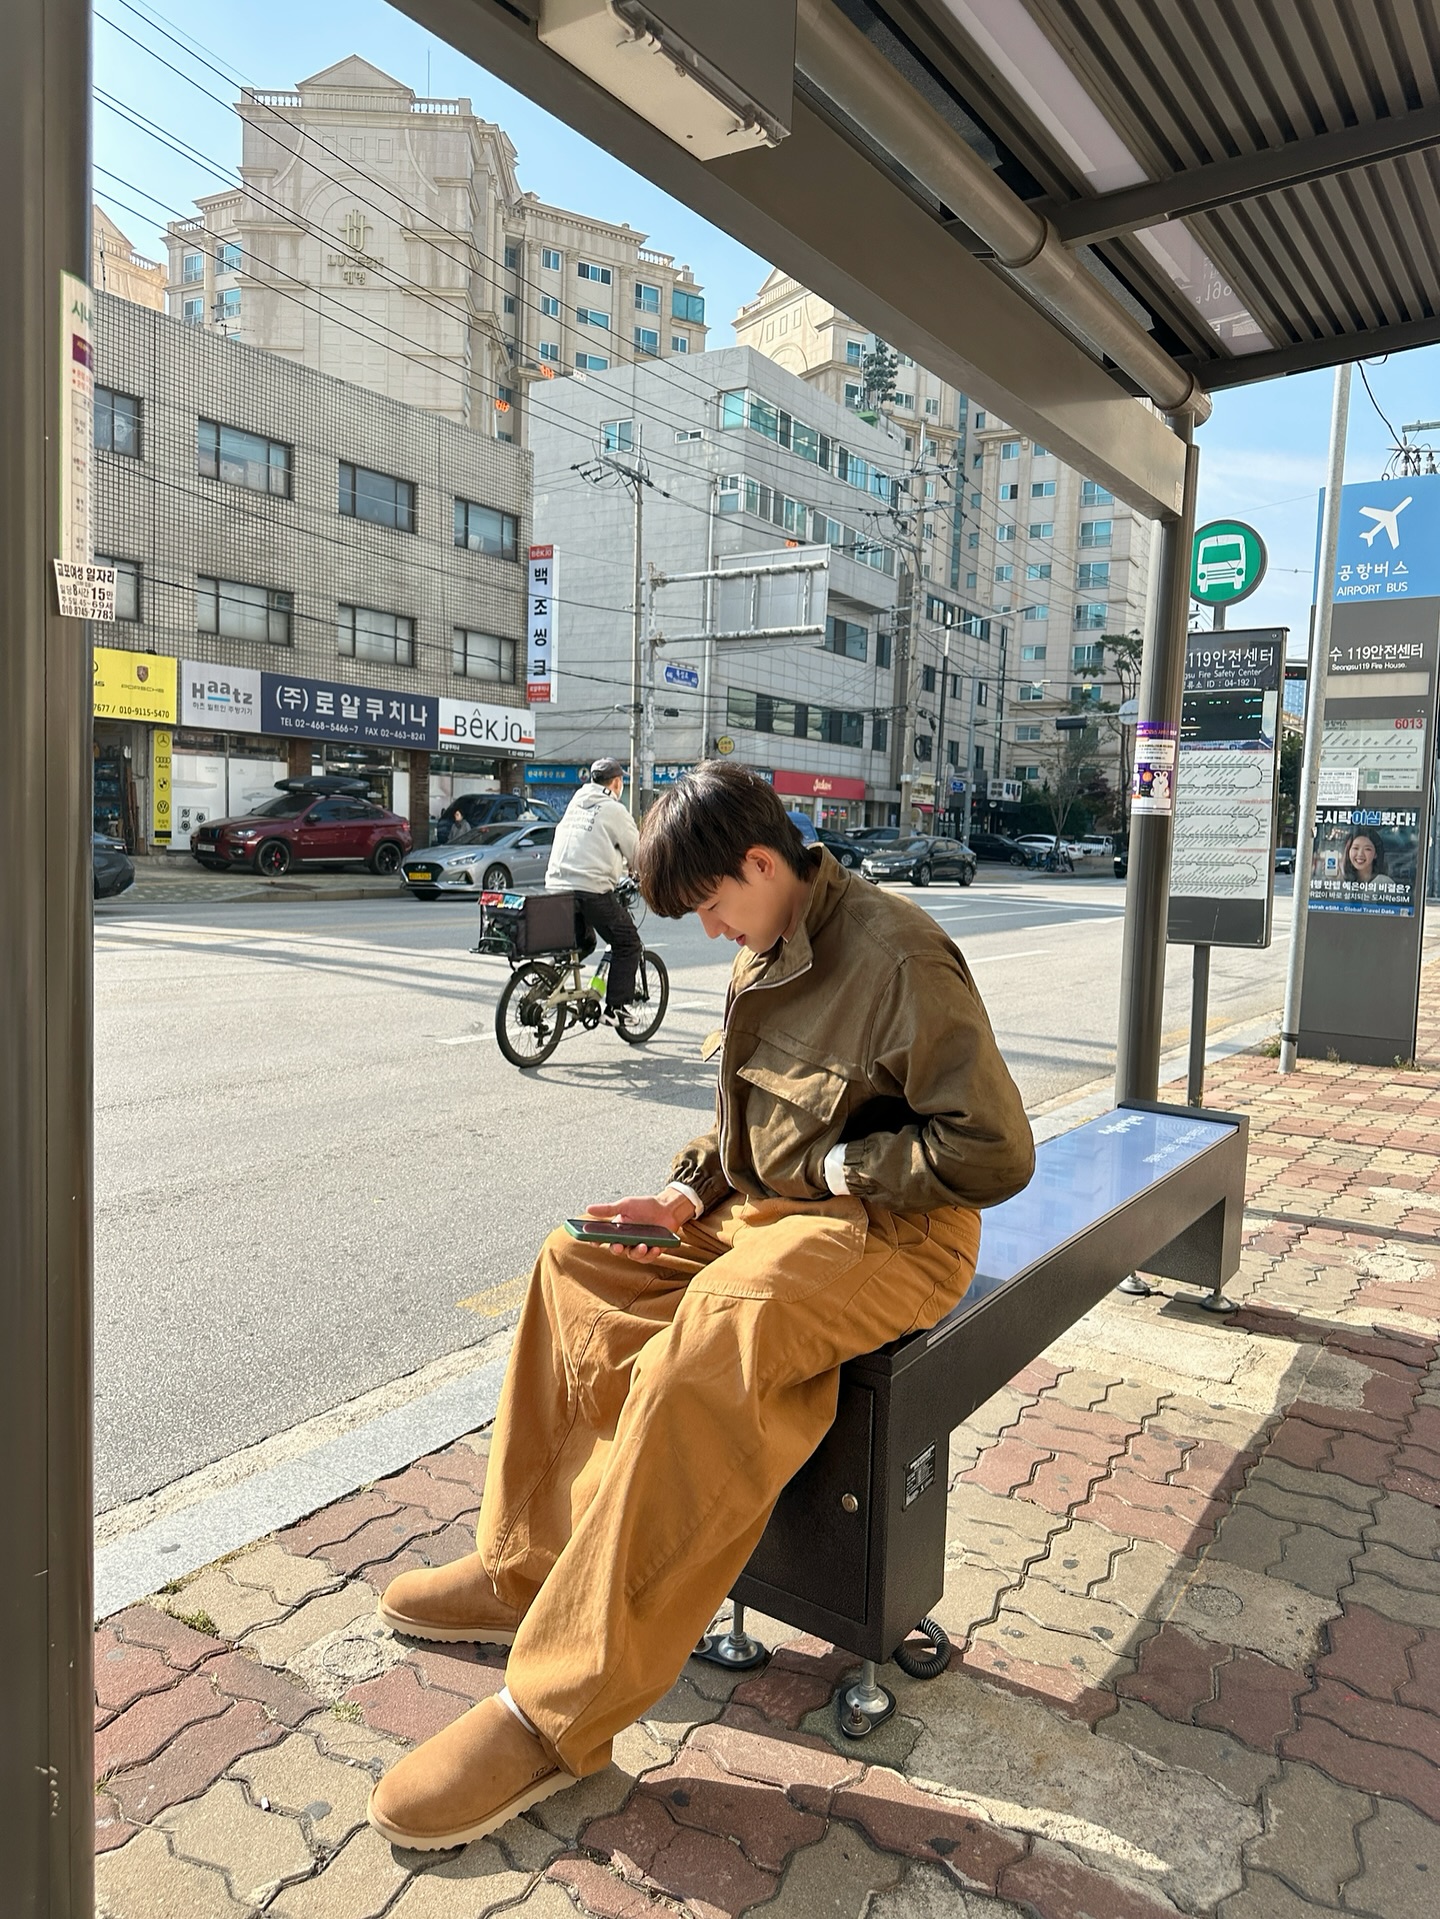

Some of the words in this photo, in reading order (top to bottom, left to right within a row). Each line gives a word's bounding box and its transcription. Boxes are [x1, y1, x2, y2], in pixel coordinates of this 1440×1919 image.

[86, 567, 114, 583] 일자리
[1337, 560, 1409, 582] 공항버스
[1336, 583, 1382, 597] AIRPORT
[1386, 581, 1408, 593] BUS
[1186, 646, 1273, 669] 119안전센터
[1347, 642, 1424, 660] 119안전센터
[1198, 670, 1211, 679] Fire
[1214, 669, 1235, 679] Safety
[1238, 668, 1261, 677] Center
[1331, 663, 1370, 671] Seongsu119
[1206, 680, 1215, 688] ID
[1224, 679, 1250, 687] 04-192
[192, 680, 253, 705] Haatz
[119, 705, 170, 719] 010-9115-5470
[275, 685, 309, 713] (주)
[315, 690, 428, 728] 로얄쿠치나
[281, 717, 293, 727] TEL
[364, 726, 379, 736] FAX
[380, 729, 426, 741] 02-463-8241
[1394, 718, 1423, 729] 6013
